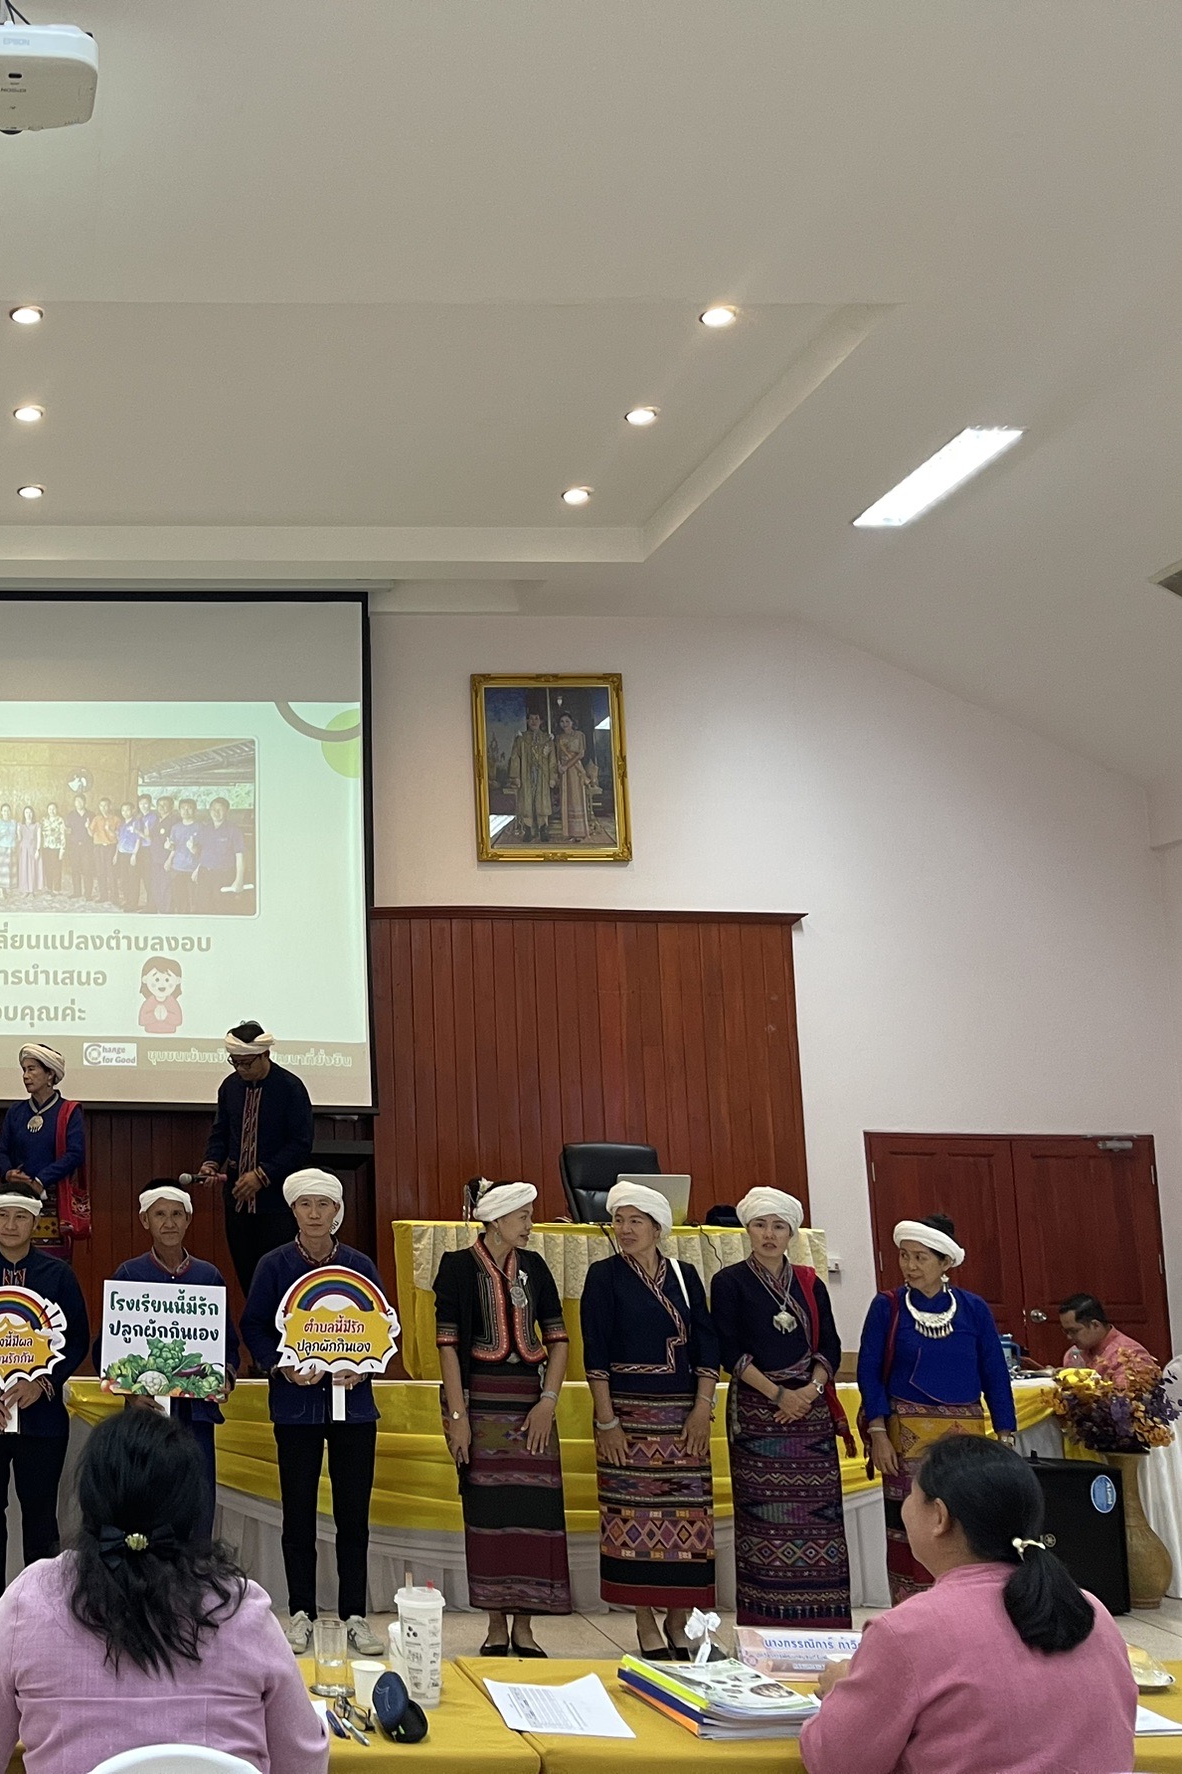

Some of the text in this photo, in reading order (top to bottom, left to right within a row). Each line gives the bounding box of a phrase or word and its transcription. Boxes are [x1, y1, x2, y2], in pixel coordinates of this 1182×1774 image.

[2, 37, 31, 46] EPSON
[102, 1055, 136, 1065] for Good
[110, 1288, 219, 1316] โรงเรียนนี้มีรัก
[108, 1318, 219, 1344] ปลูกผักกินเอง
[303, 1314, 365, 1334] ตำบลนี้มีรัก
[296, 1337, 371, 1356] ปลูกผักกินเอง
